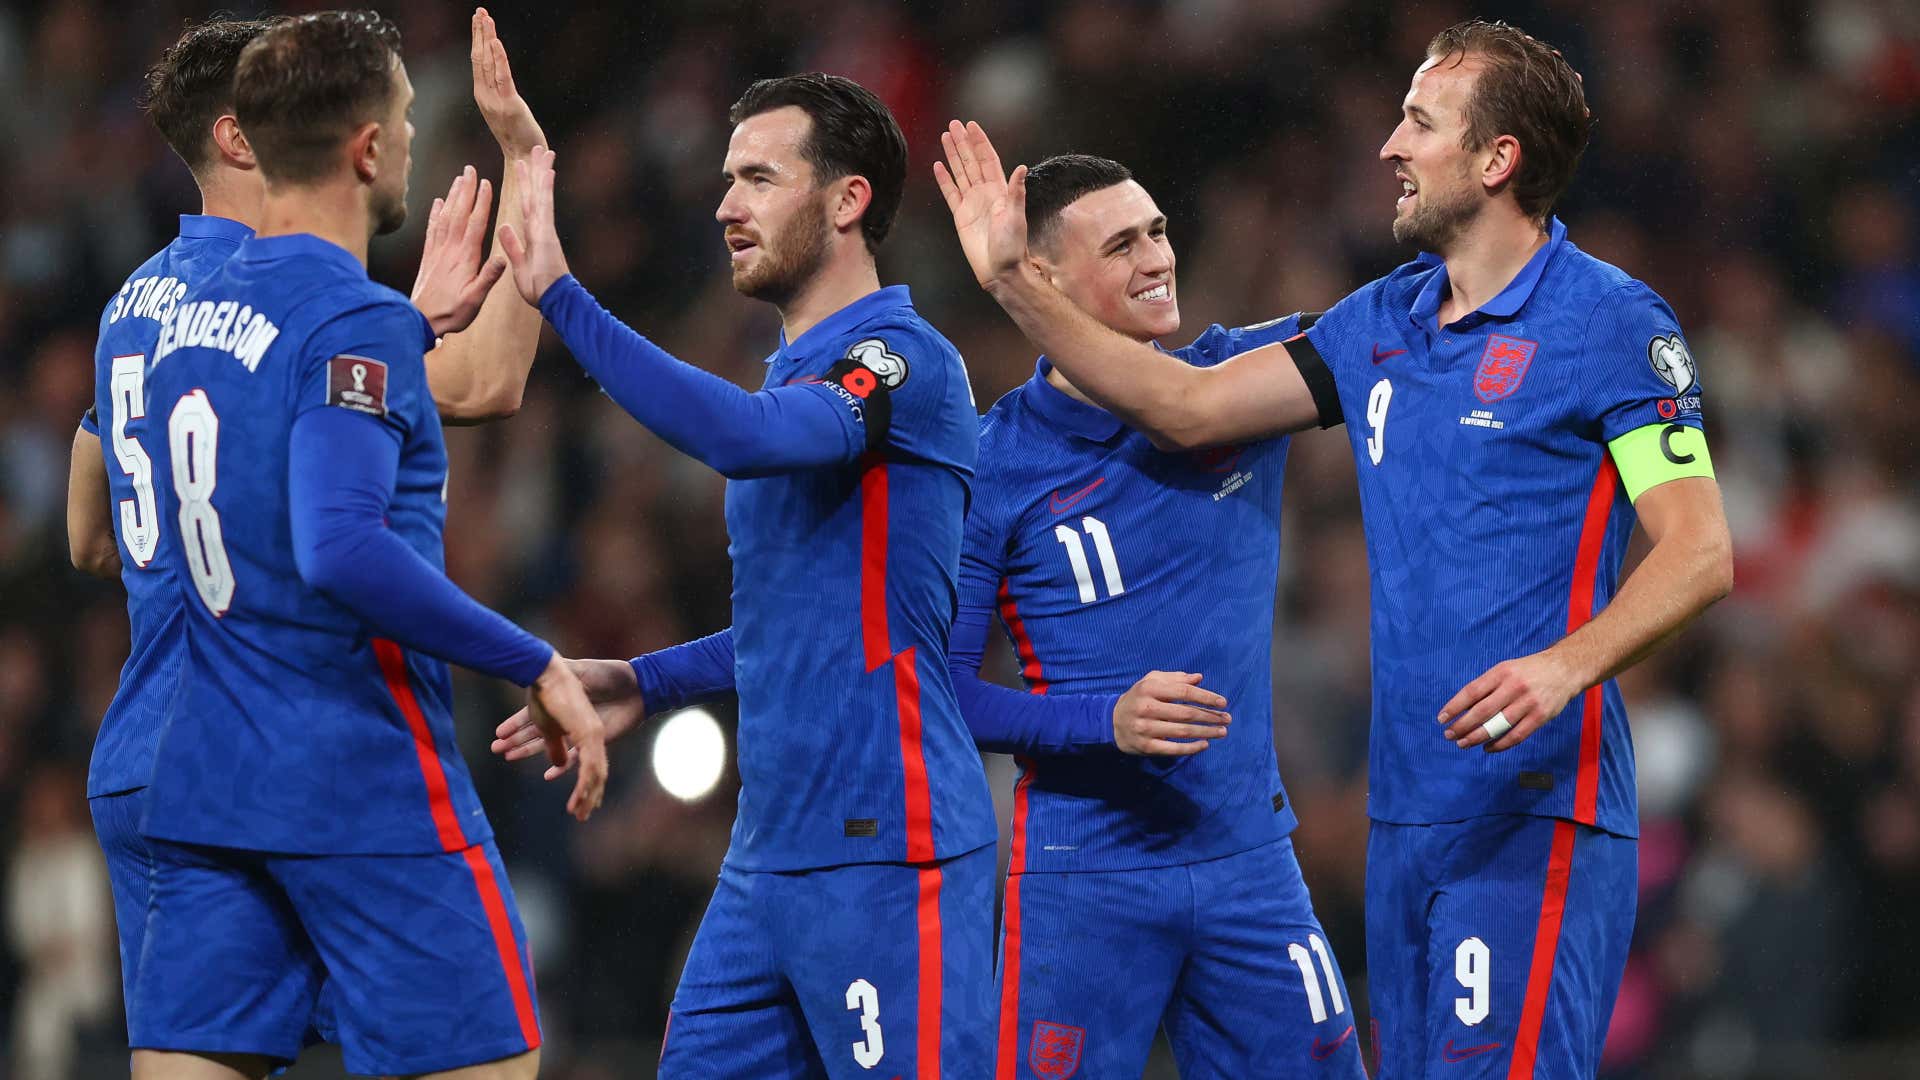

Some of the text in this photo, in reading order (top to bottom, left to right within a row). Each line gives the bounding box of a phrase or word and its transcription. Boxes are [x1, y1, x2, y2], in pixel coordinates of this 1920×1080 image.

[109, 276, 187, 325] STONES
[822, 380, 864, 423] RESPECT
[1364, 378, 1393, 466] 9
[1660, 424, 1696, 465] C
[110, 354, 160, 568] 5
[168, 388, 237, 619] 8
[1054, 516, 1125, 604] 11
[844, 978, 886, 1069] 3
[1287, 933, 1346, 1025] 11
[1455, 936, 1491, 1027] 9
